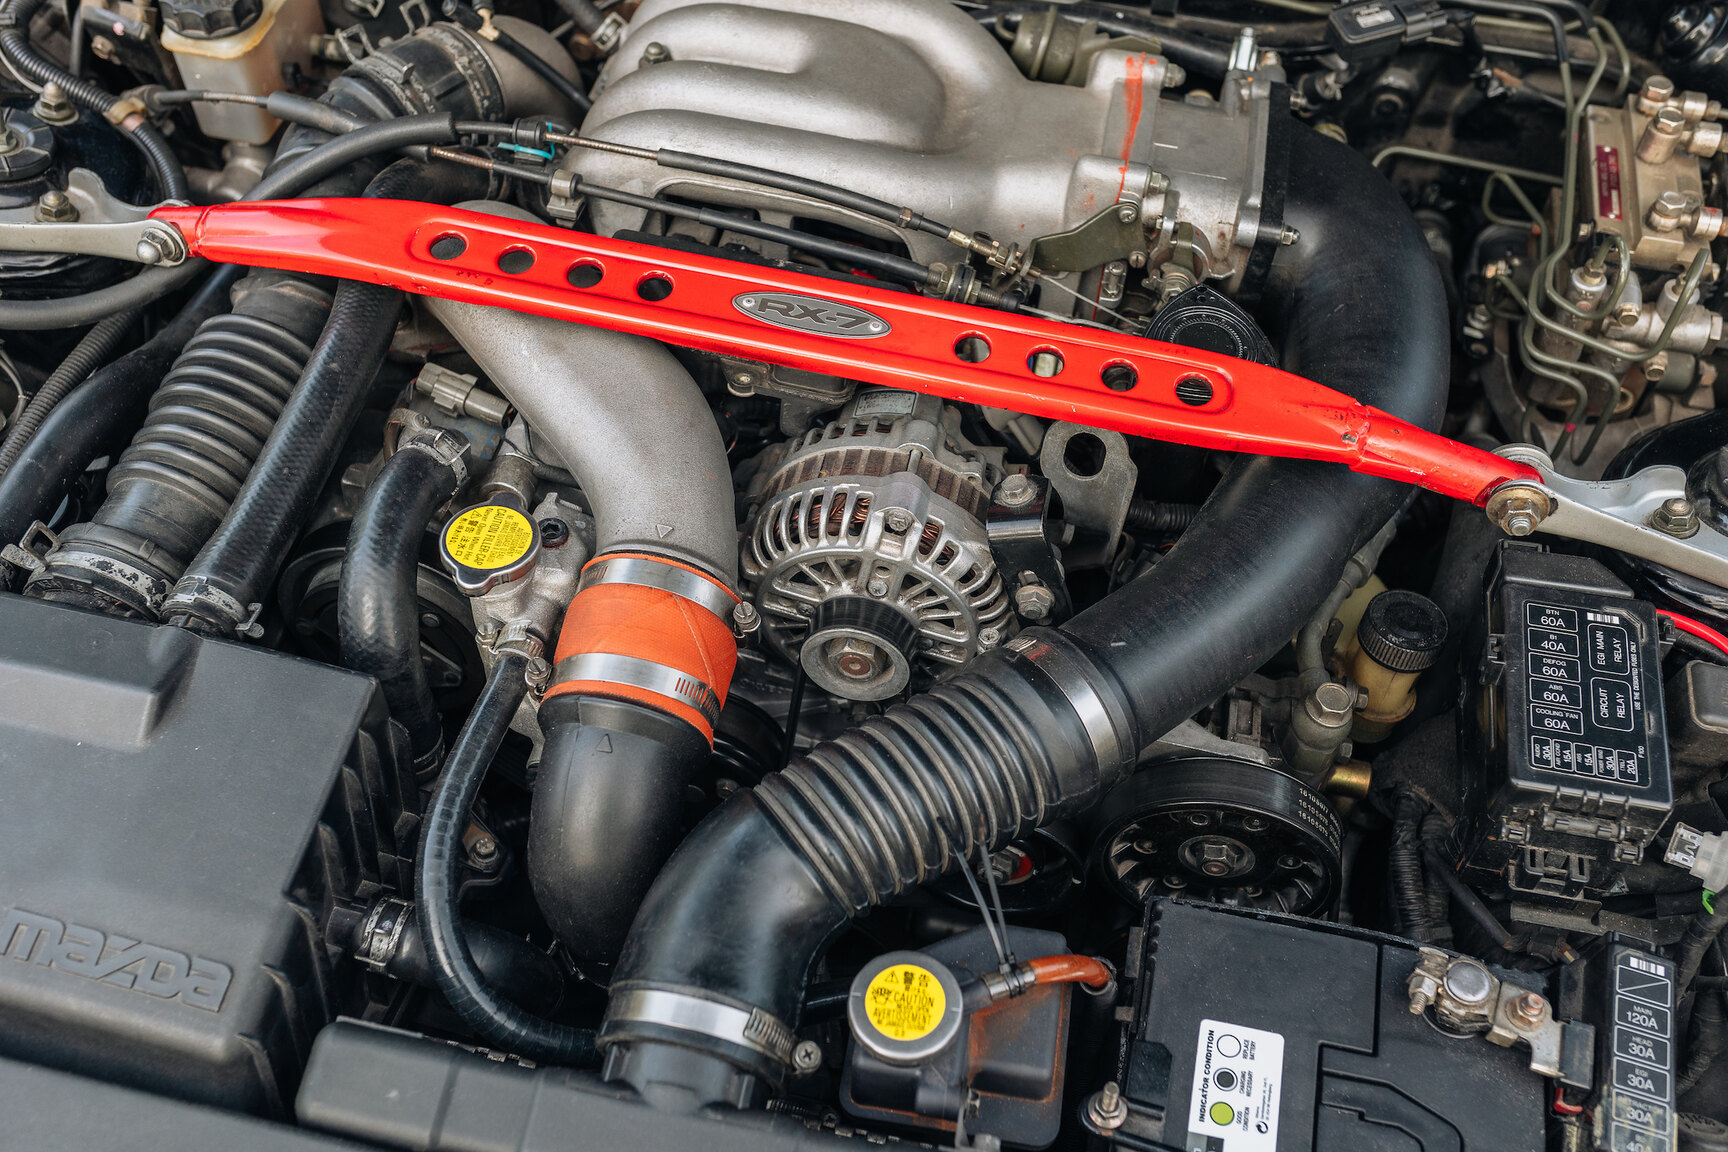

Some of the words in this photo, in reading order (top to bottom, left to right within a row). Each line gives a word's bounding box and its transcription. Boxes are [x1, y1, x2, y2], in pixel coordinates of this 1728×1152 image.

[758, 298, 870, 329] RX-7
[482, 508, 494, 522] Never
[488, 508, 507, 533] CAUTION
[465, 520, 479, 533] 警告
[475, 522, 486, 535] Open
[468, 536, 480, 550] When
[1541, 616, 1565, 628] 60A
[1541, 640, 1566, 652] 40A
[1596, 630, 1604, 650] MAIN
[1613, 638, 1622, 663] RELAY
[1543, 658, 1566, 666] DEFOG
[1597, 652, 1605, 665] EGI
[1543, 666, 1568, 678] 60A
[1544, 691, 1569, 704] 60A
[1599, 688, 1609, 718] CIRCUIT
[1536, 708, 1563, 717] COOLING
[1616, 693, 1625, 718] RELAY
[1545, 718, 1570, 730] 60A
[1543, 746, 1551, 760] 30A
[1563, 750, 1571, 762] 15A
[1584, 753, 1592, 766] 15A
[1606, 756, 1614, 770] 30A
[1627, 760, 1635, 775] 20A
[894, 991, 934, 1007] CAUTION
[874, 1008, 931, 1024] AVERTISSEMENT
[1633, 1005, 1652, 1016] MAIN
[1626, 1012, 1658, 1030] 120A
[1632, 1036, 1653, 1047] HEAD
[1628, 1042, 1656, 1060] 30A
[1199, 1078, 1209, 1122] INDICATOR
[1204, 1030, 1214, 1075] CONDITION
[1635, 1068, 1648, 1078] EGI
[1627, 1074, 1655, 1092] 30A
[1627, 1107, 1654, 1126] 30A
